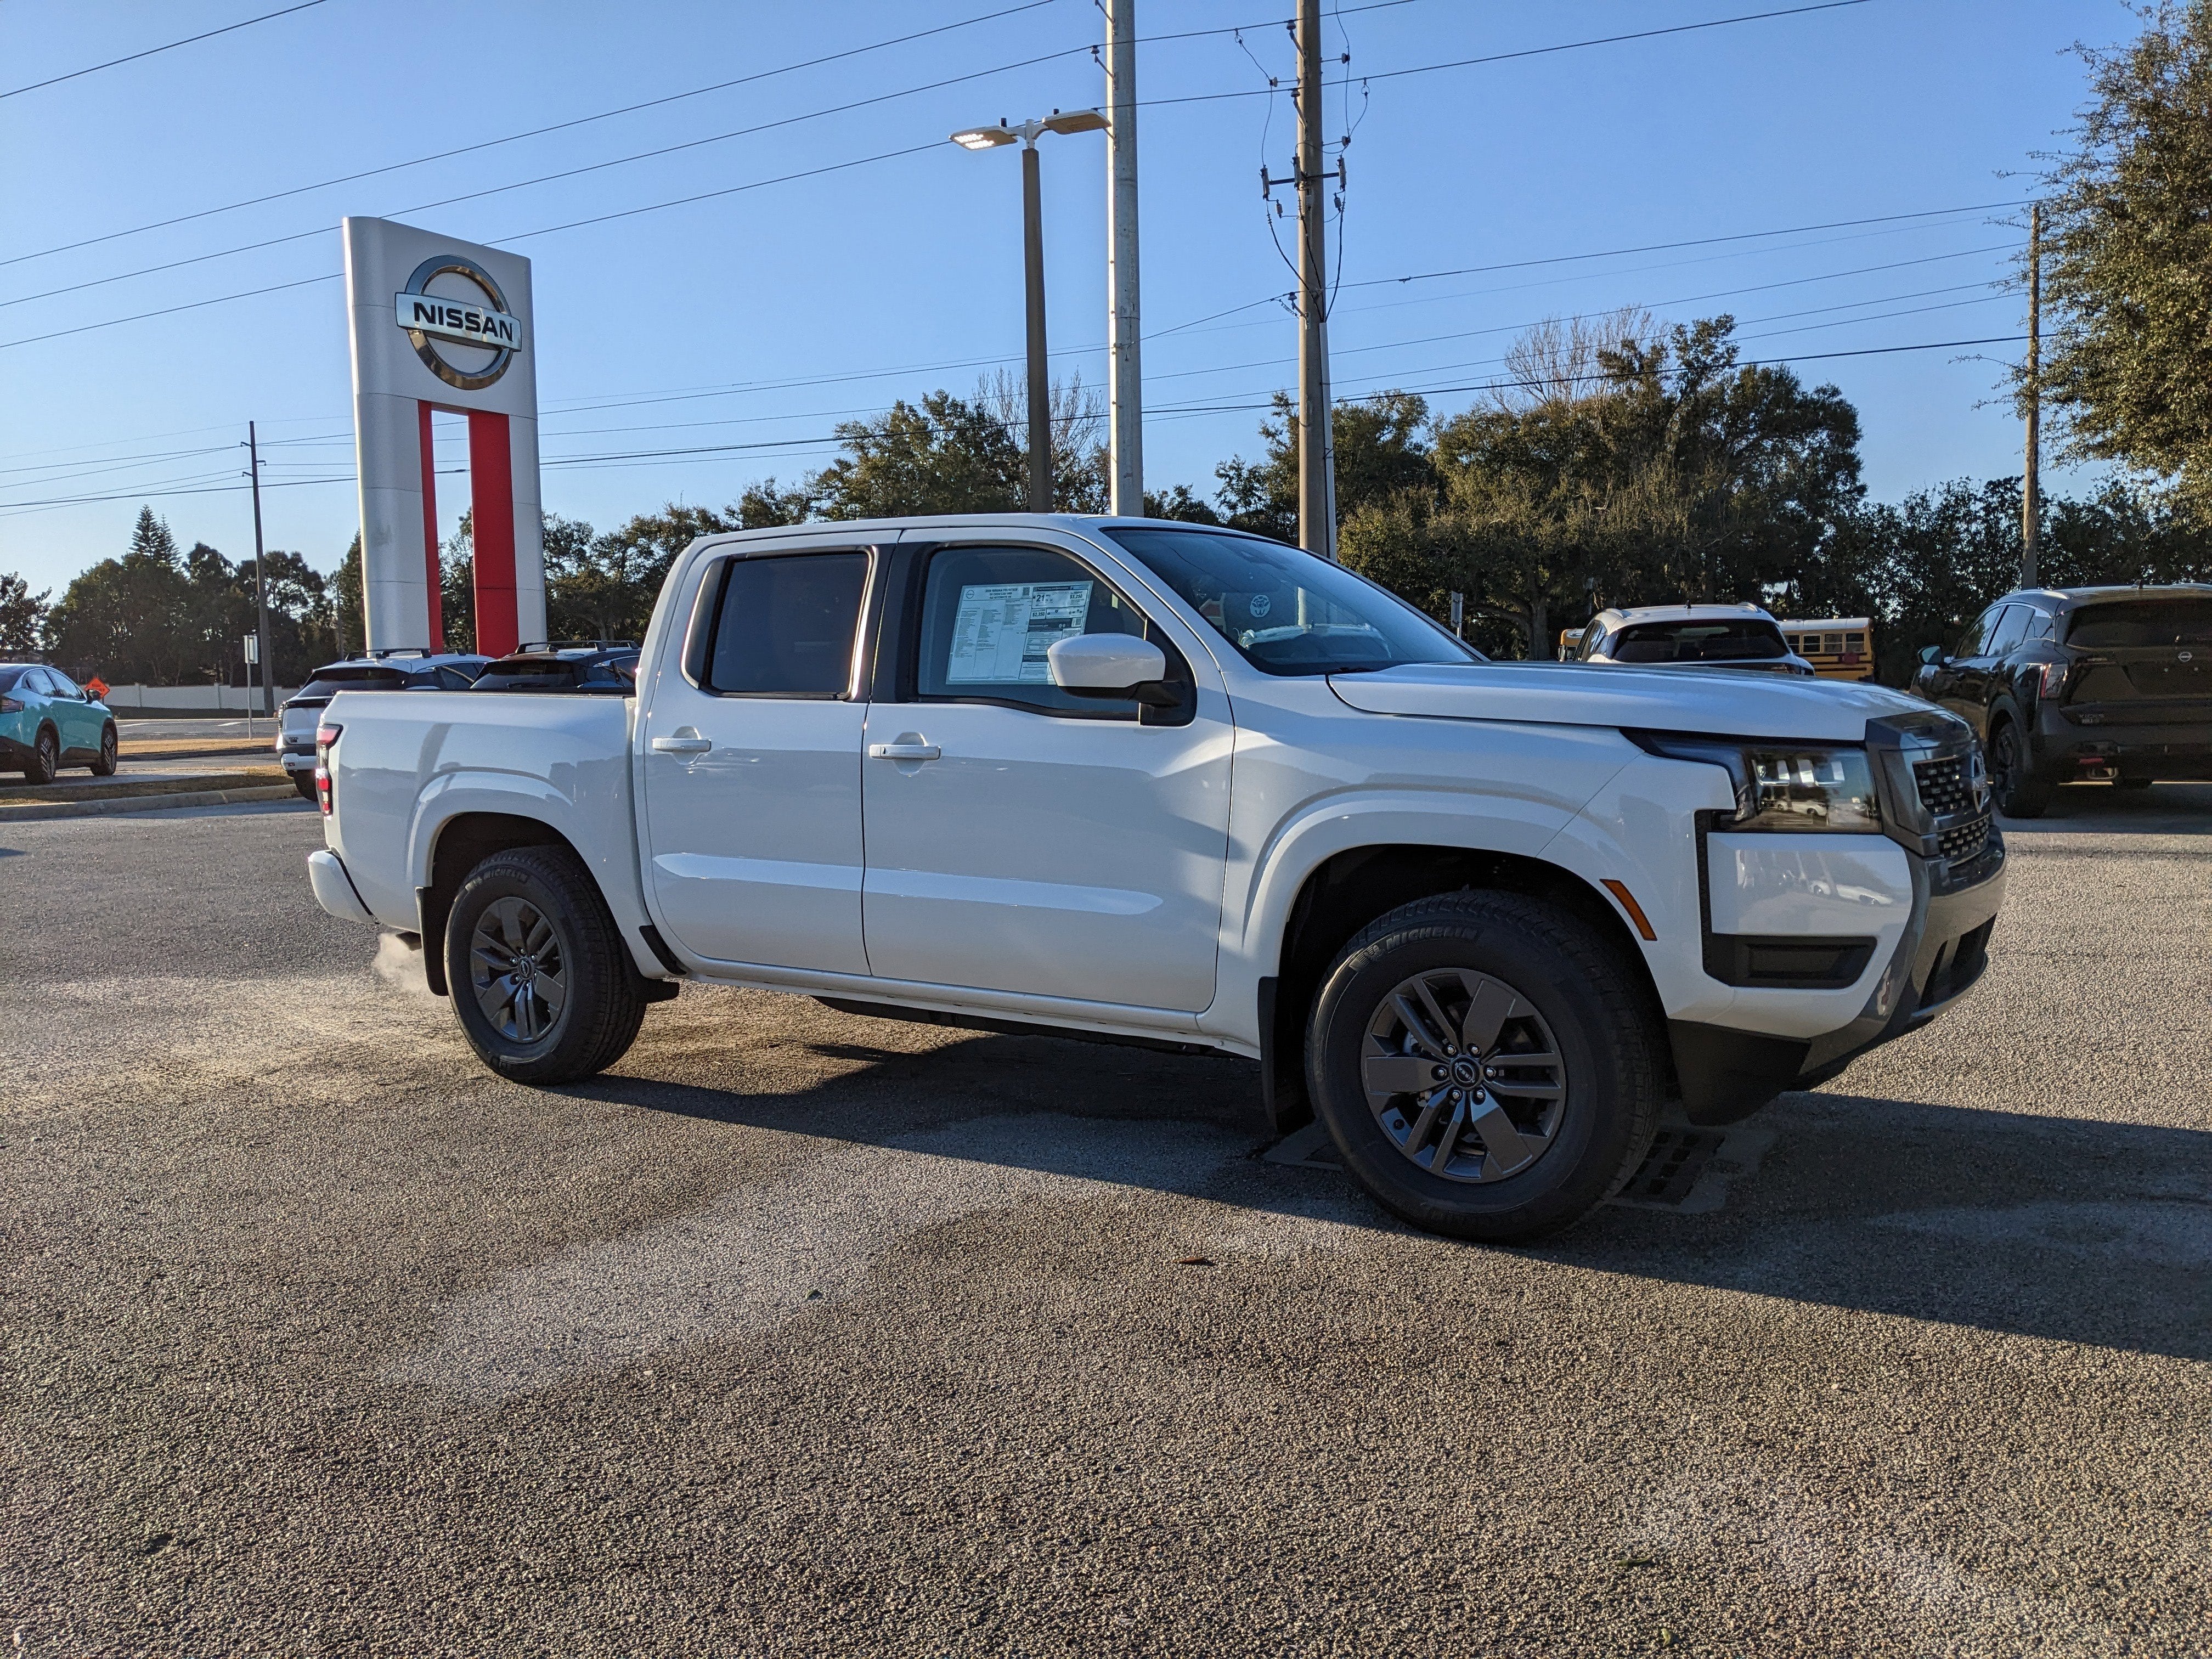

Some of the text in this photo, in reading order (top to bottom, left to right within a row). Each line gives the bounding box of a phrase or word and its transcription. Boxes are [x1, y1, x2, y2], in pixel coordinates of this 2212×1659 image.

[413, 302, 513, 342] NISSAN
[483, 868, 527, 883] MICHELIN
[1386, 927, 1477, 950] MICHELIN
